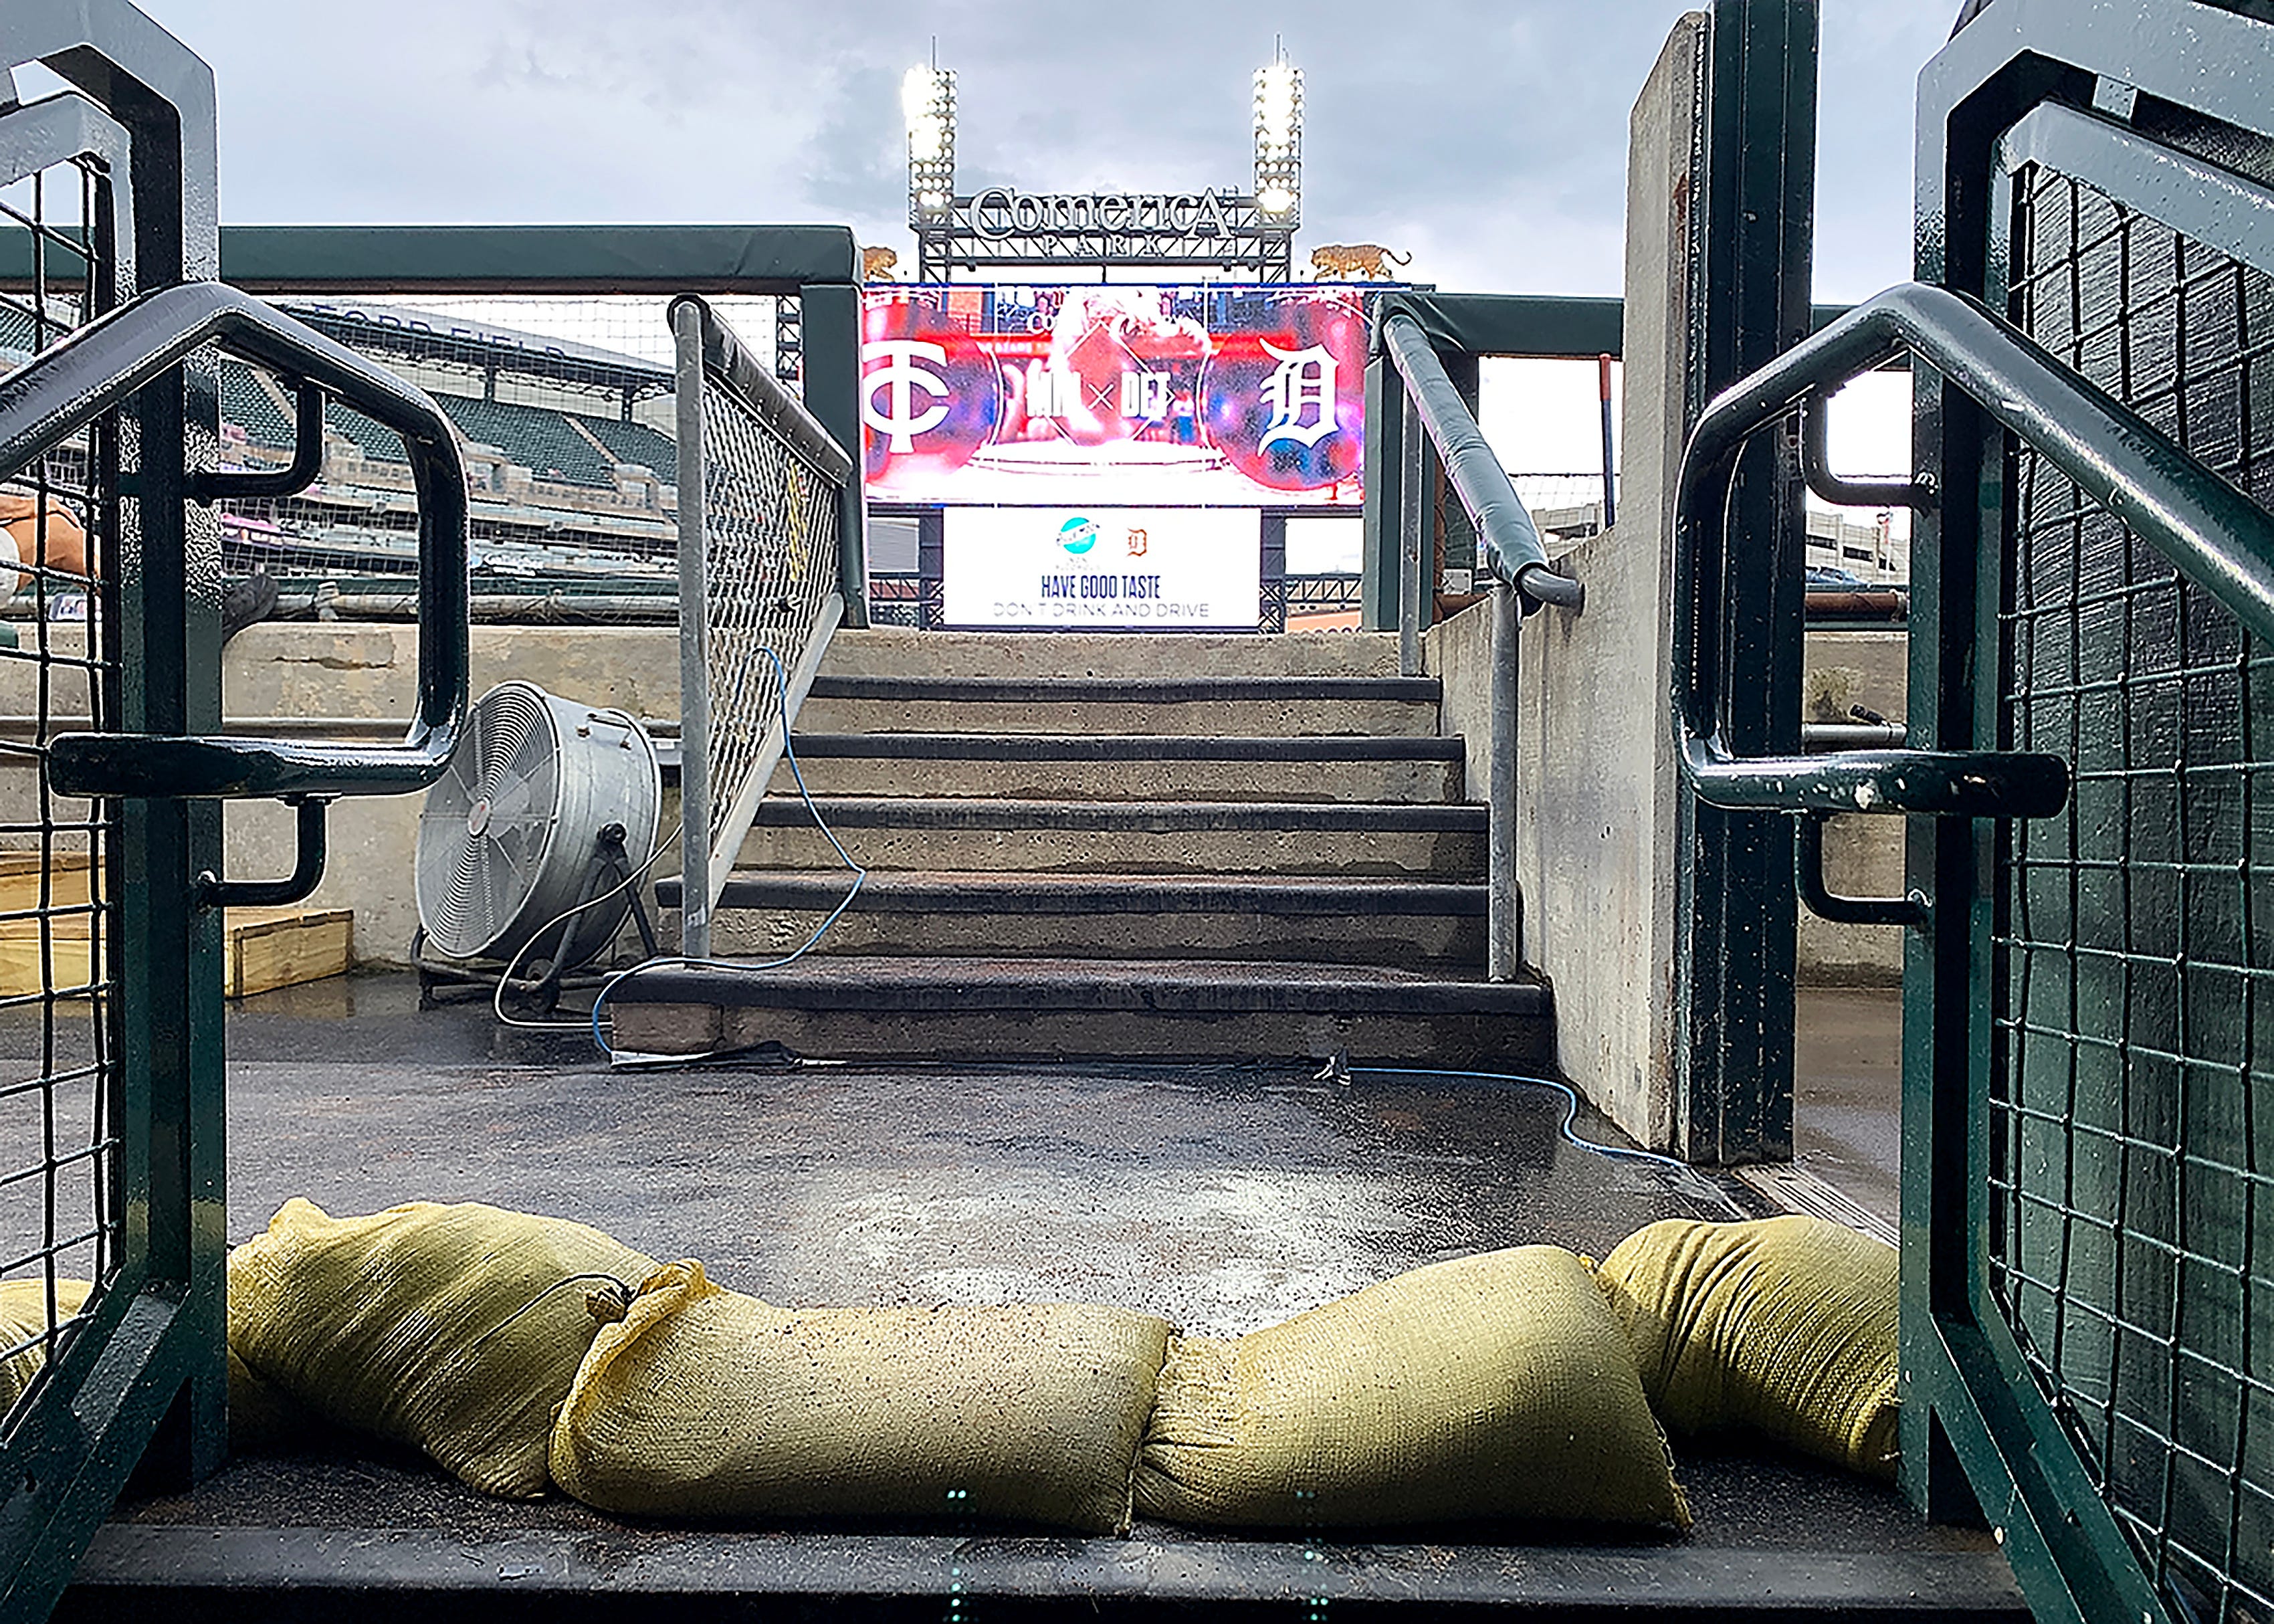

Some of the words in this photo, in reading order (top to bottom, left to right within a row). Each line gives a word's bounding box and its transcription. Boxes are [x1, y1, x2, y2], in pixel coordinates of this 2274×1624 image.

[1042, 235, 1161, 257] PARK
[1121, 371, 1170, 418] DET
[1041, 575, 1076, 599] HAVE
[1121, 575, 1161, 599] TASTE
[993, 602, 1047, 617] DONT
[1052, 602, 1106, 617] DRINK
[1111, 602, 1151, 617] AND
[1156, 602, 1209, 617] DRIVE
